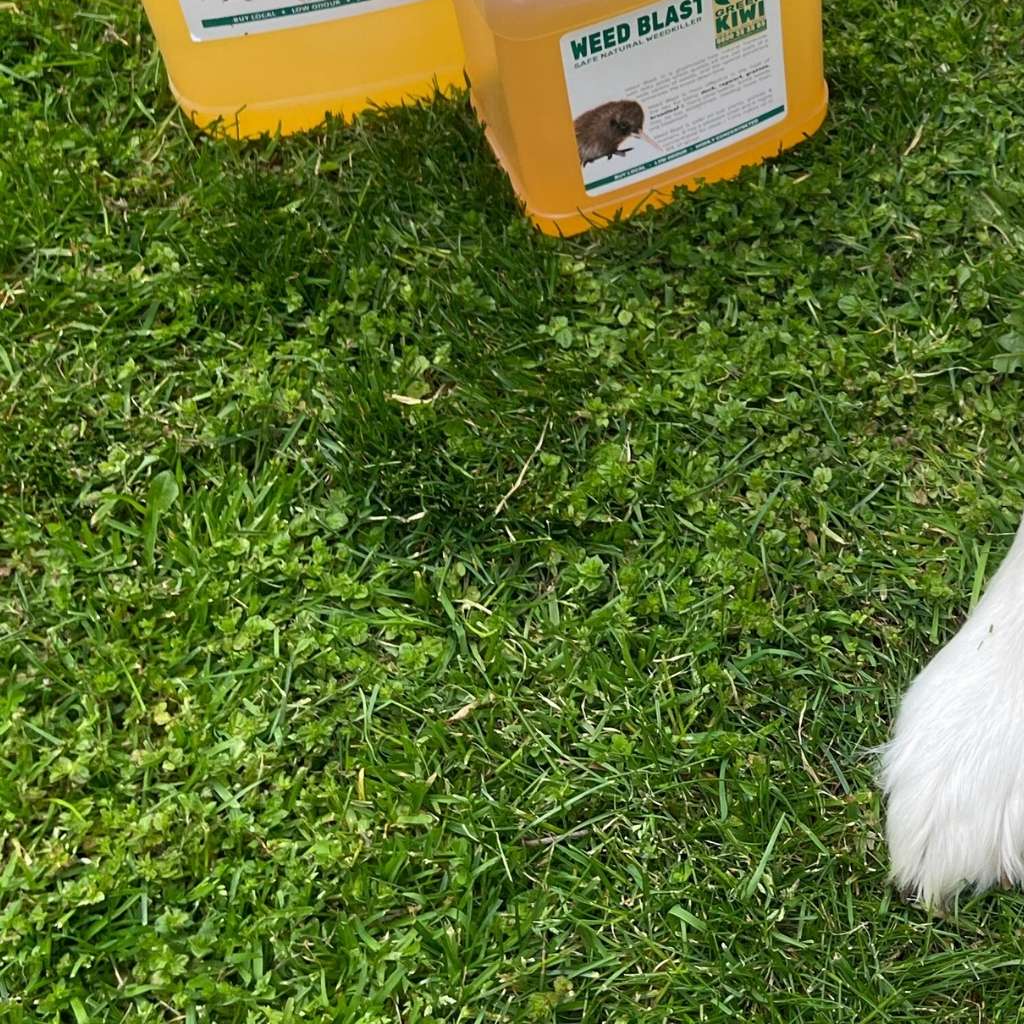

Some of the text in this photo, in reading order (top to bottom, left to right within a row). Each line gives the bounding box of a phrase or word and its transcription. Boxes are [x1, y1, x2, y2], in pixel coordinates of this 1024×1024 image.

[715, 0, 765, 34] KIWI
[570, 23, 631, 61] WEED
[574, 57, 601, 69] SAFE
[600, 39, 643, 59] NATURAL
[645, 16, 702, 42] WEEDKILLER
